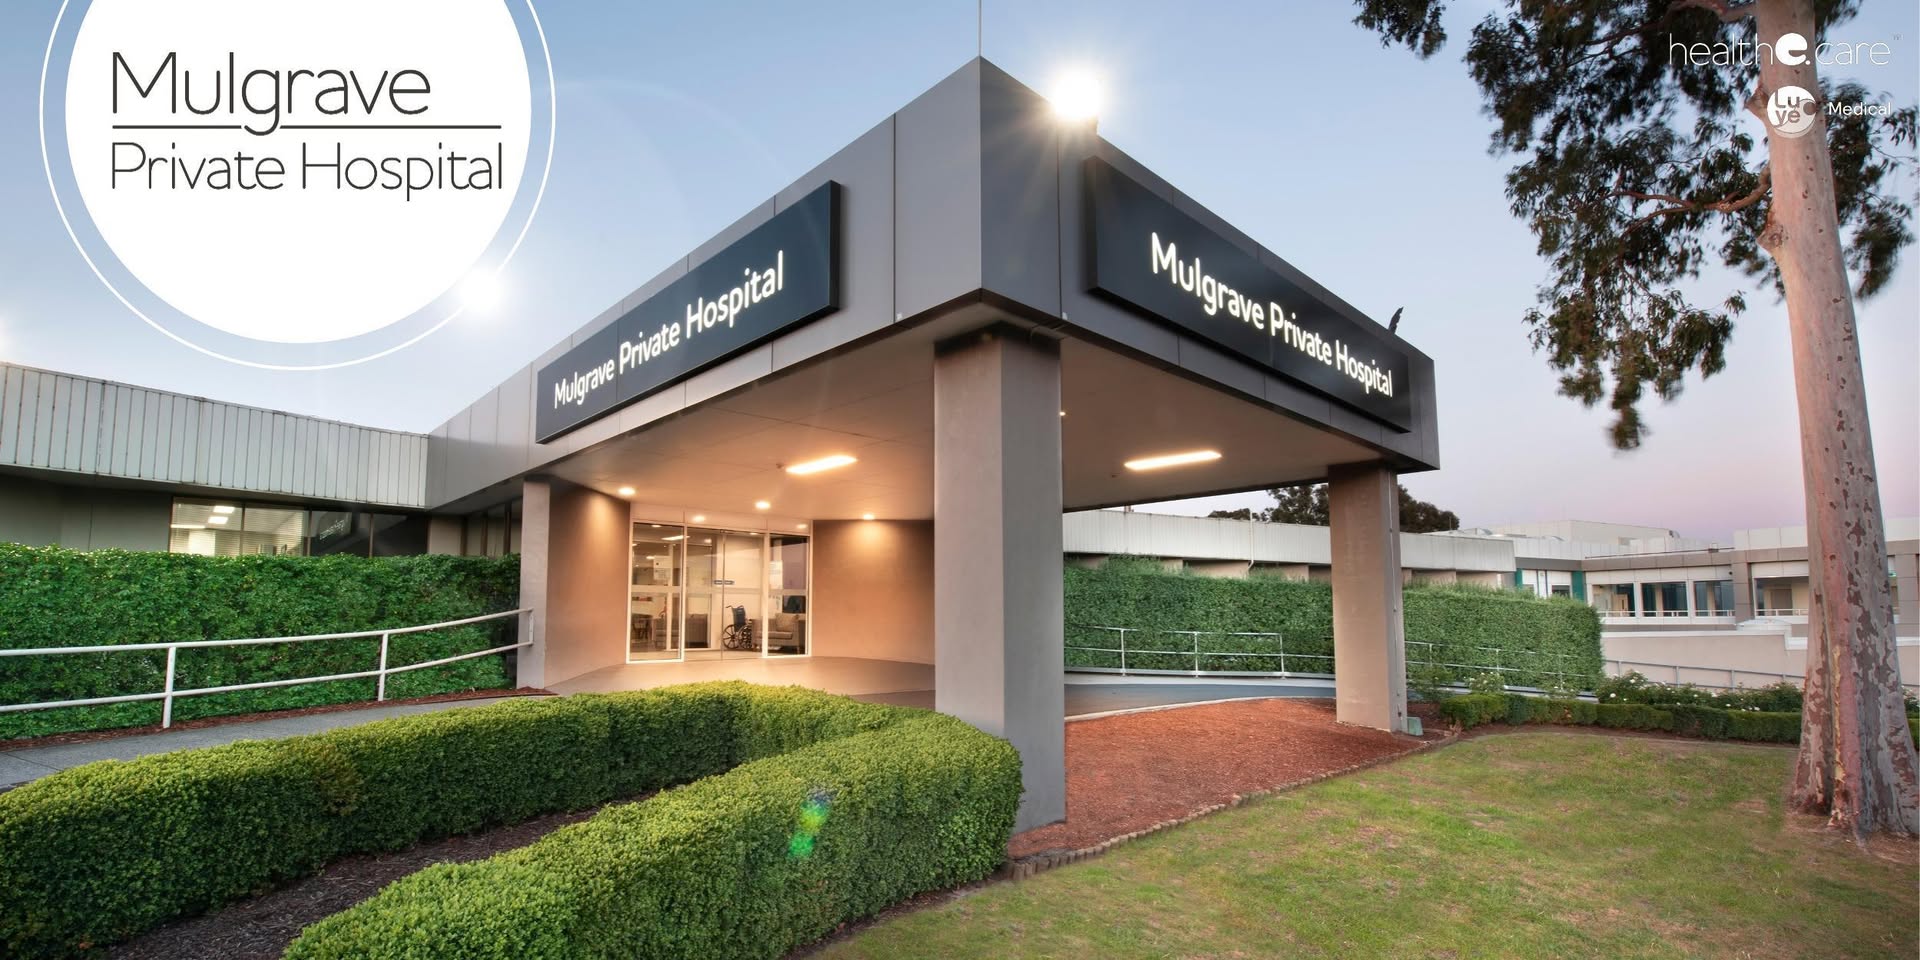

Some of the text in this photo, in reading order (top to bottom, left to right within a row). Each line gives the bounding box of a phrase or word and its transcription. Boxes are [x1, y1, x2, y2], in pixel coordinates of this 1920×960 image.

[553, 250, 784, 409] Mulgrave Private Hospital
[1151, 232, 1393, 398] Mulgrave Private Hospital
